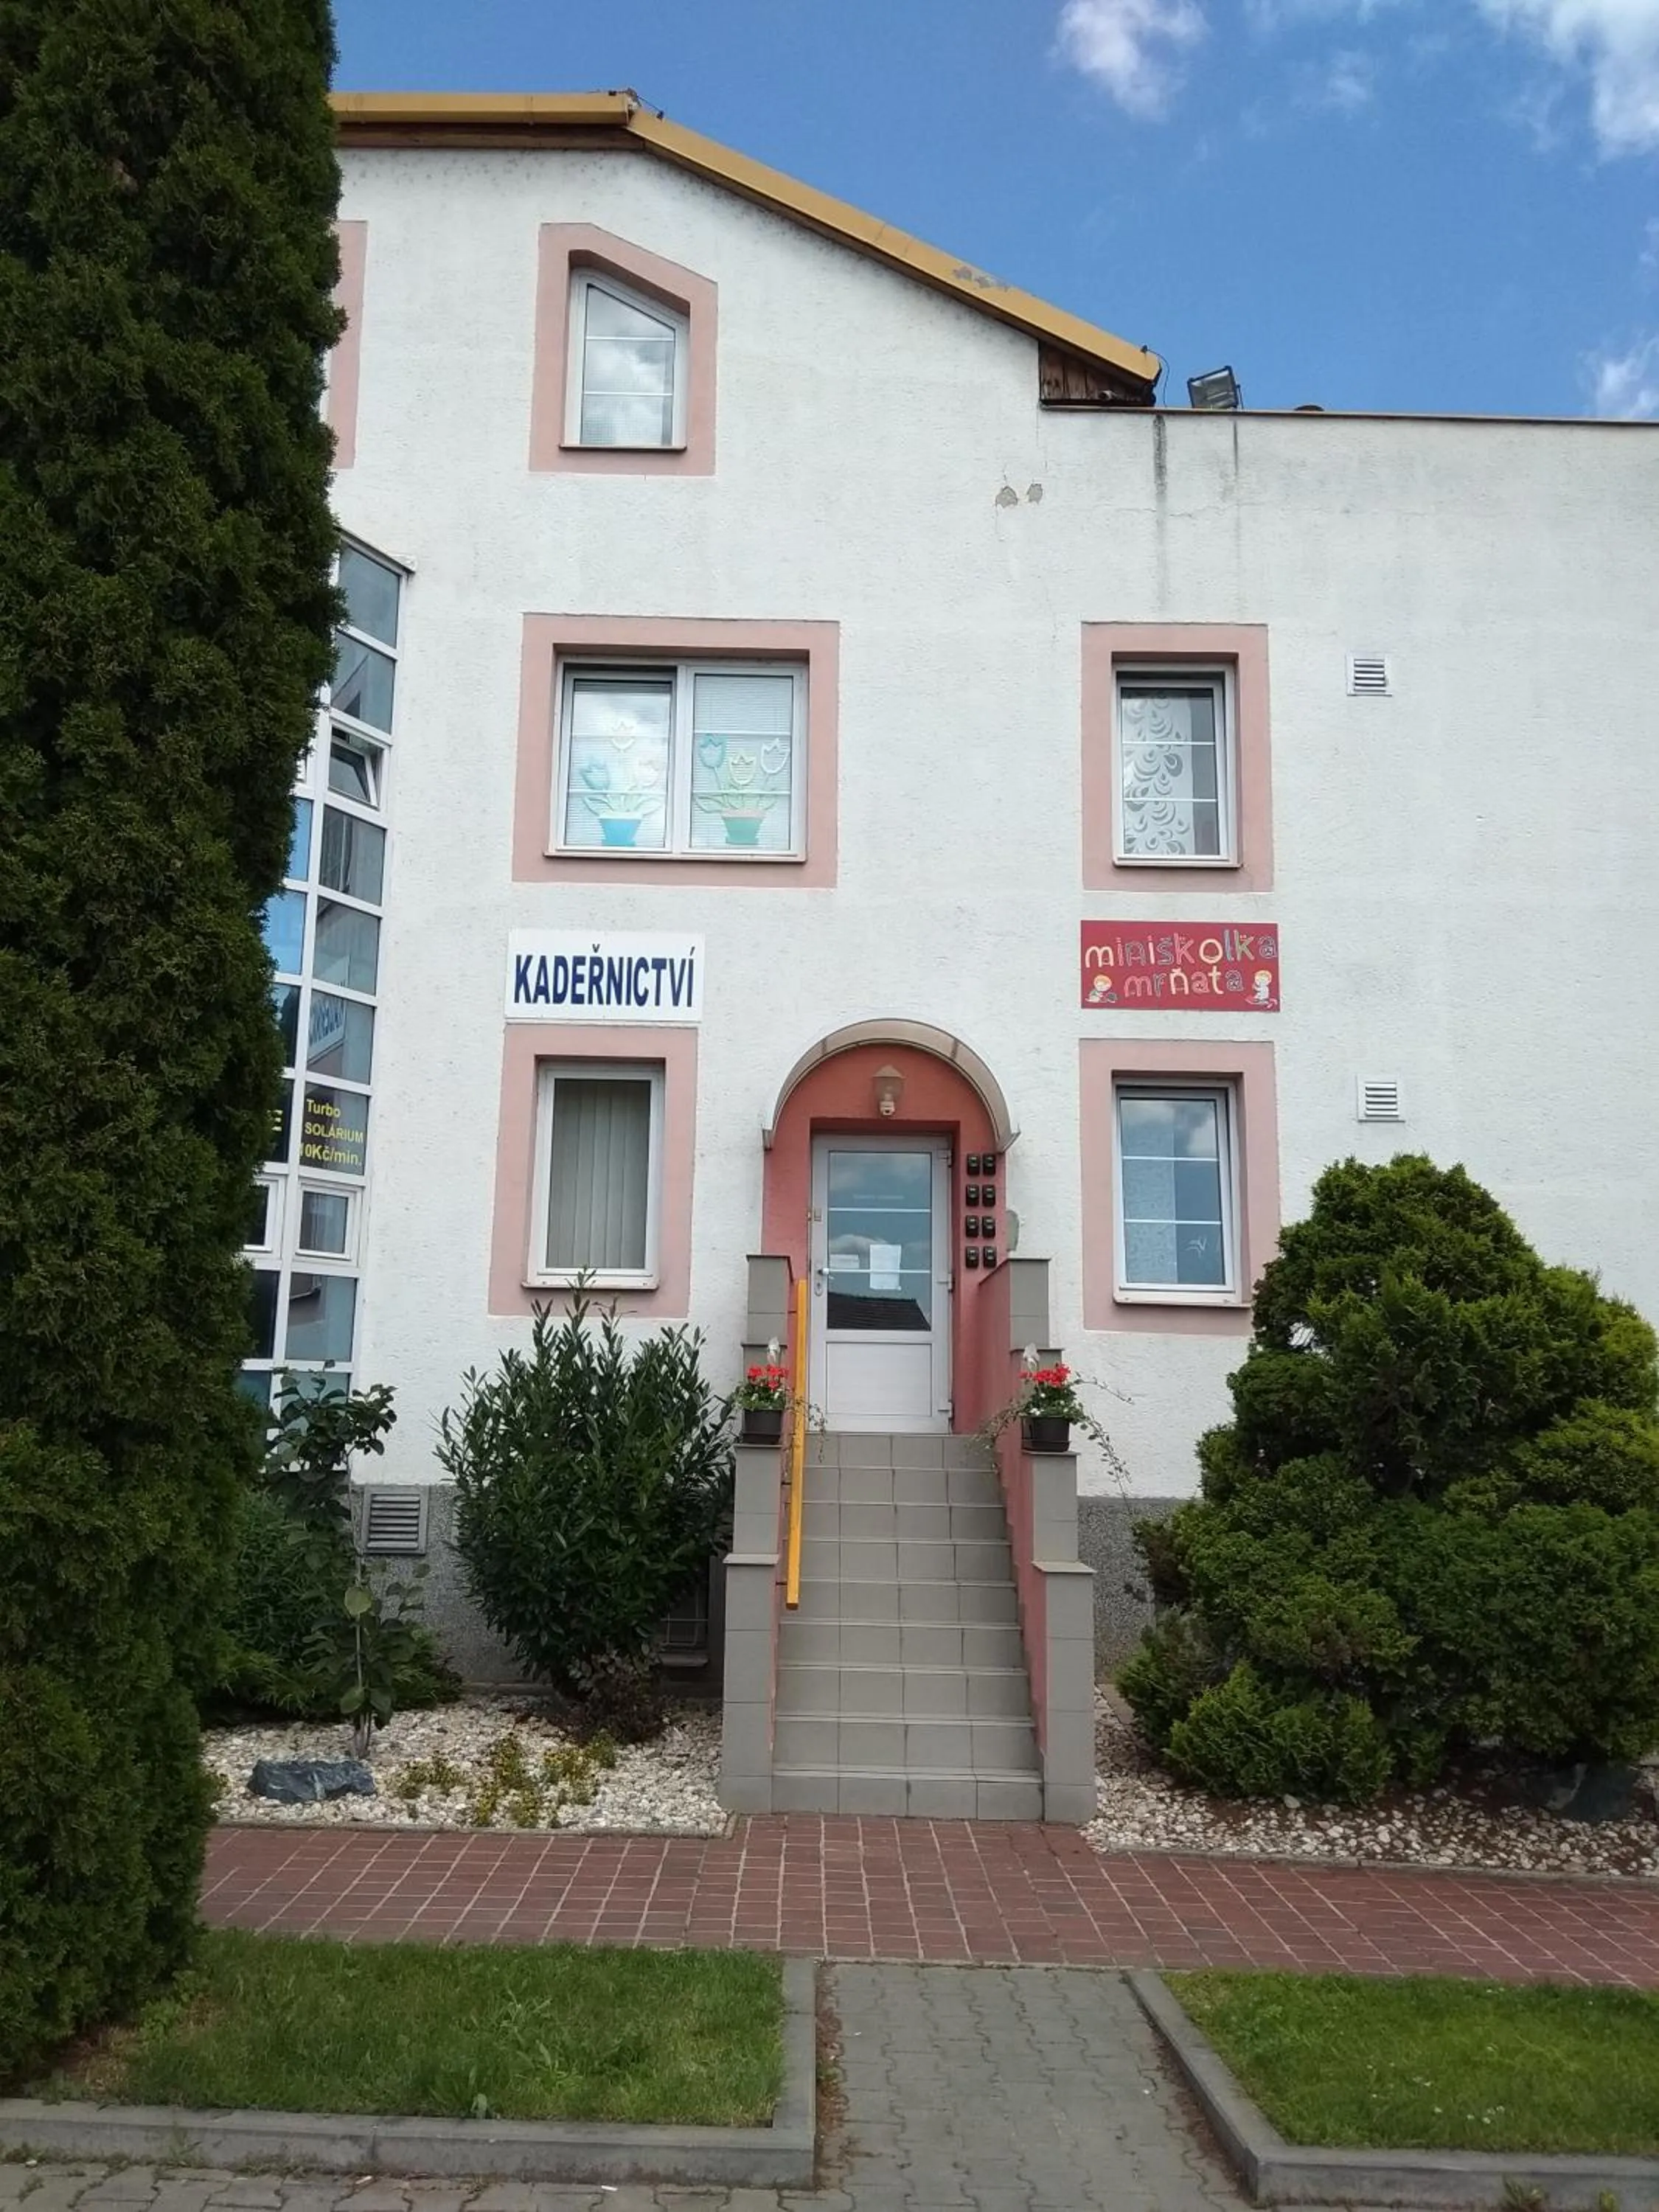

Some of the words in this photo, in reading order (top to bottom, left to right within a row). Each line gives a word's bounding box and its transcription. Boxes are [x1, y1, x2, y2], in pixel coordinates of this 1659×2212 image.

[514, 943, 695, 1007] KADEŘNICTVÍ
[1123, 965, 1245, 998] mrňata
[306, 1099, 341, 1118] Turbo
